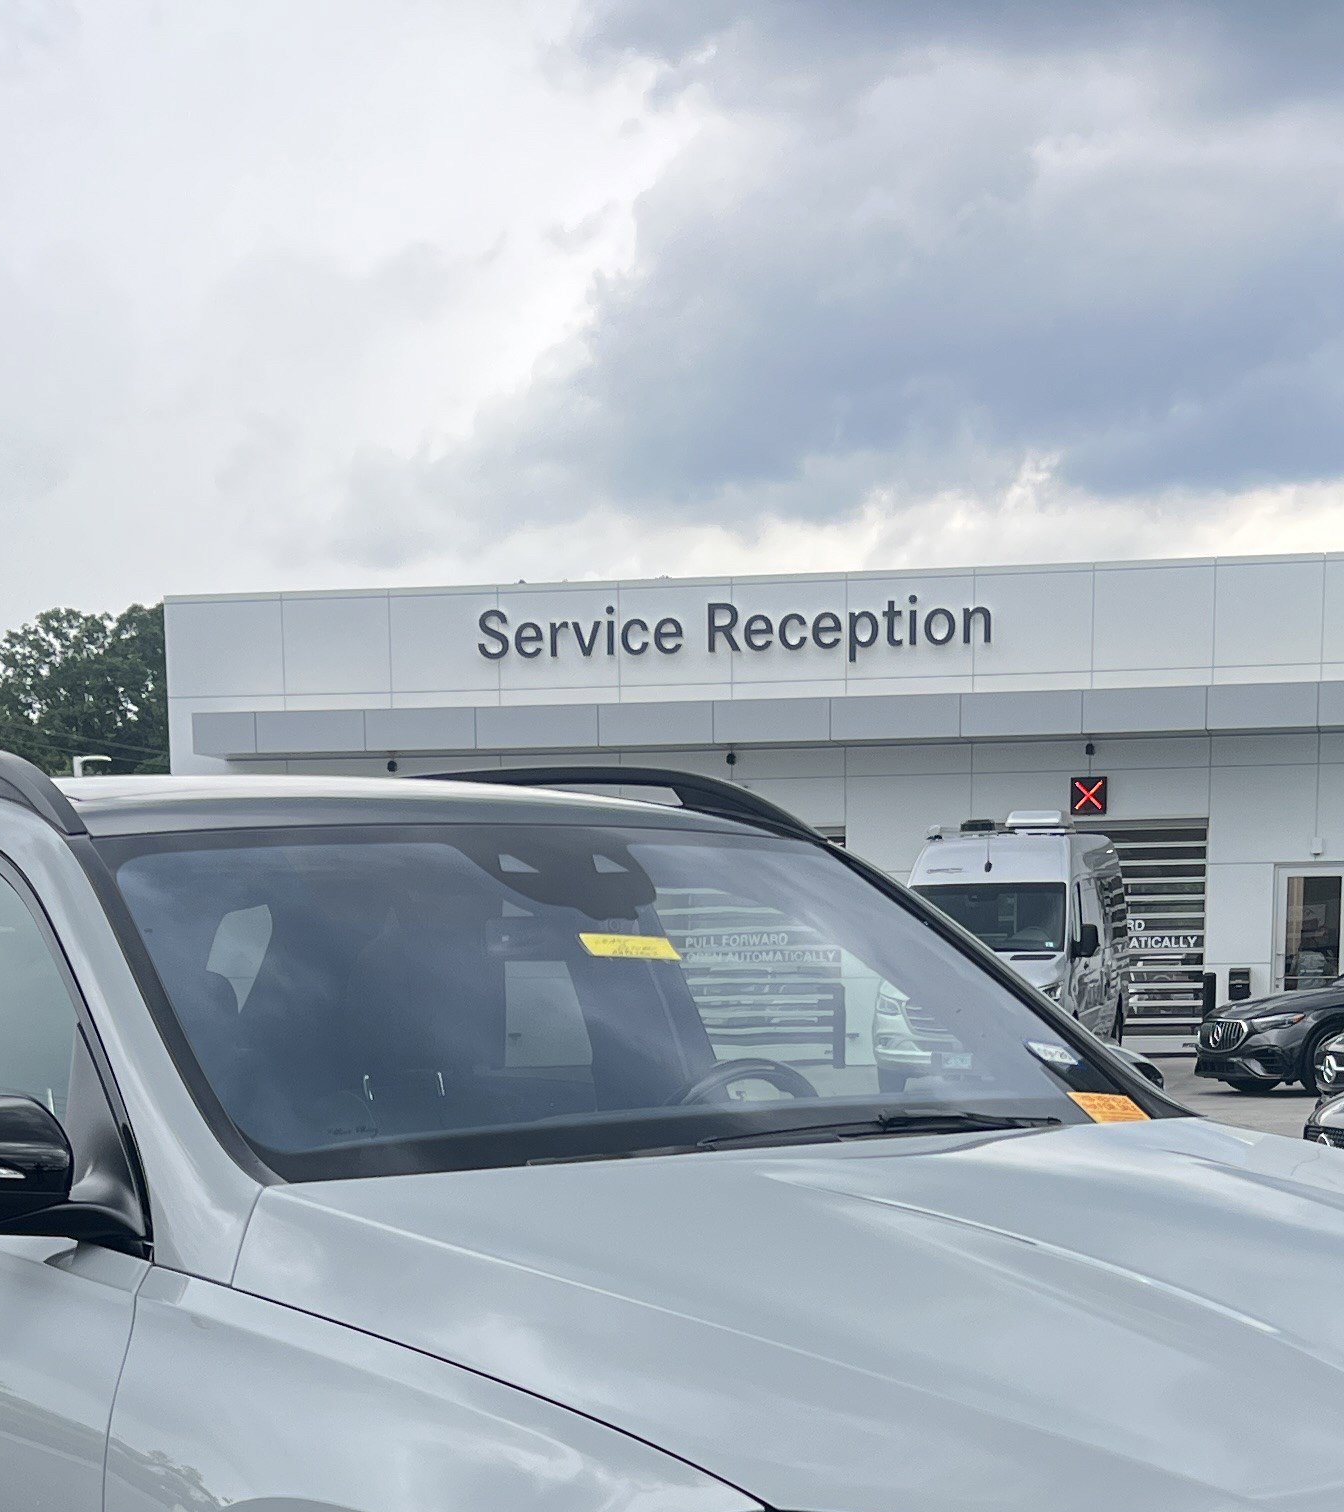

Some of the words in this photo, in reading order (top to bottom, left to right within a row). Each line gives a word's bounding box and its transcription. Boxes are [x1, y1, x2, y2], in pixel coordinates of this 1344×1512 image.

[477, 605, 684, 661] Service
[707, 594, 992, 663] Reception
[685, 935, 721, 949] PULL
[722, 933, 788, 947] FORWARD
[1129, 936, 1197, 948] ATICALLY
[727, 950, 836, 964] AUTOMATICALLY
